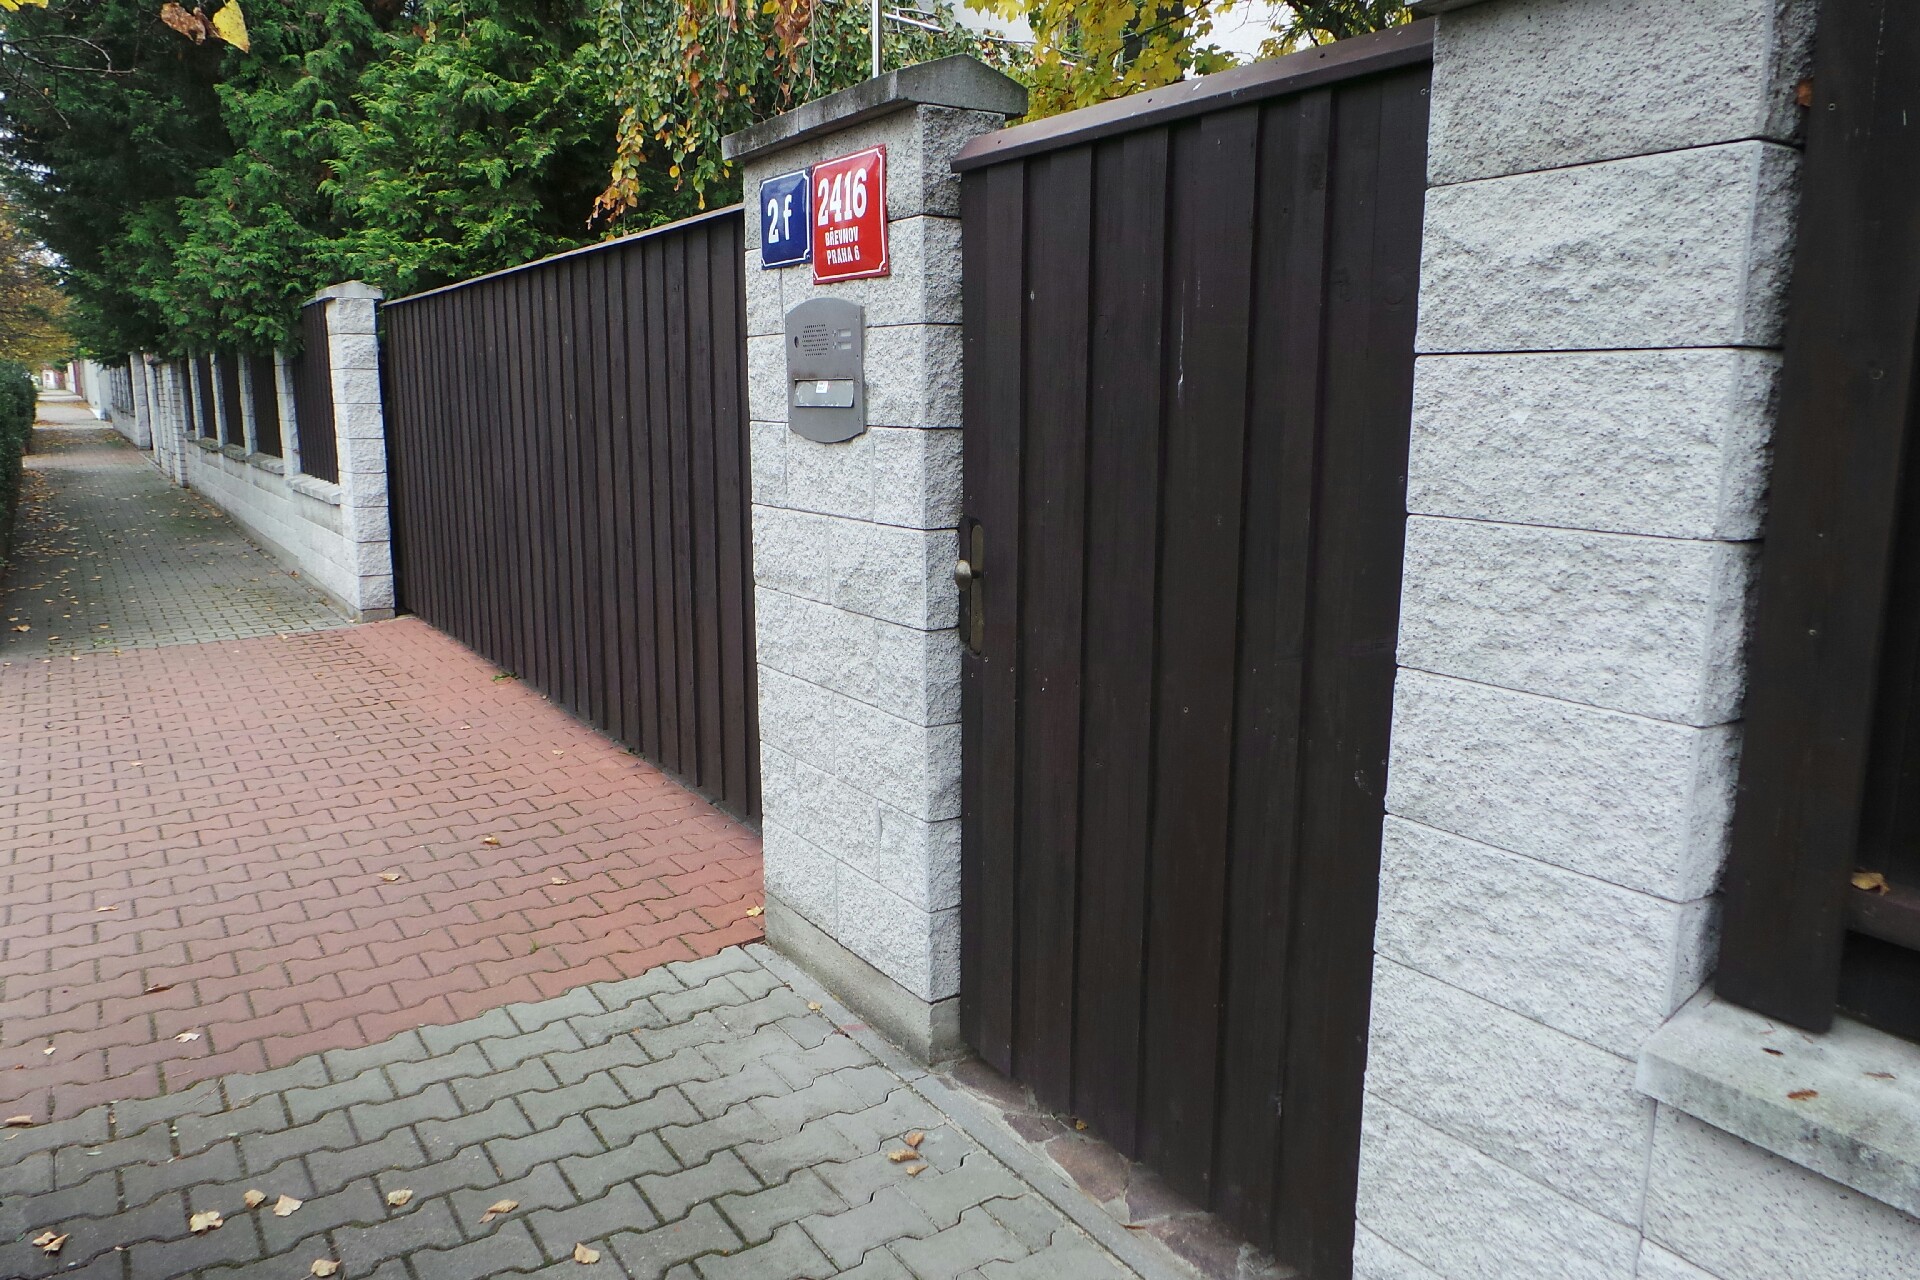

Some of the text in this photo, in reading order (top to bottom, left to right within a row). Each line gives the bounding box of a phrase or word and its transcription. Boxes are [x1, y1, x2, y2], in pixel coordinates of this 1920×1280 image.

[817, 168, 867, 226] 2416
[825, 226, 859, 246] BŘEVNOV
[827, 246, 860, 265] PRAHA 6
